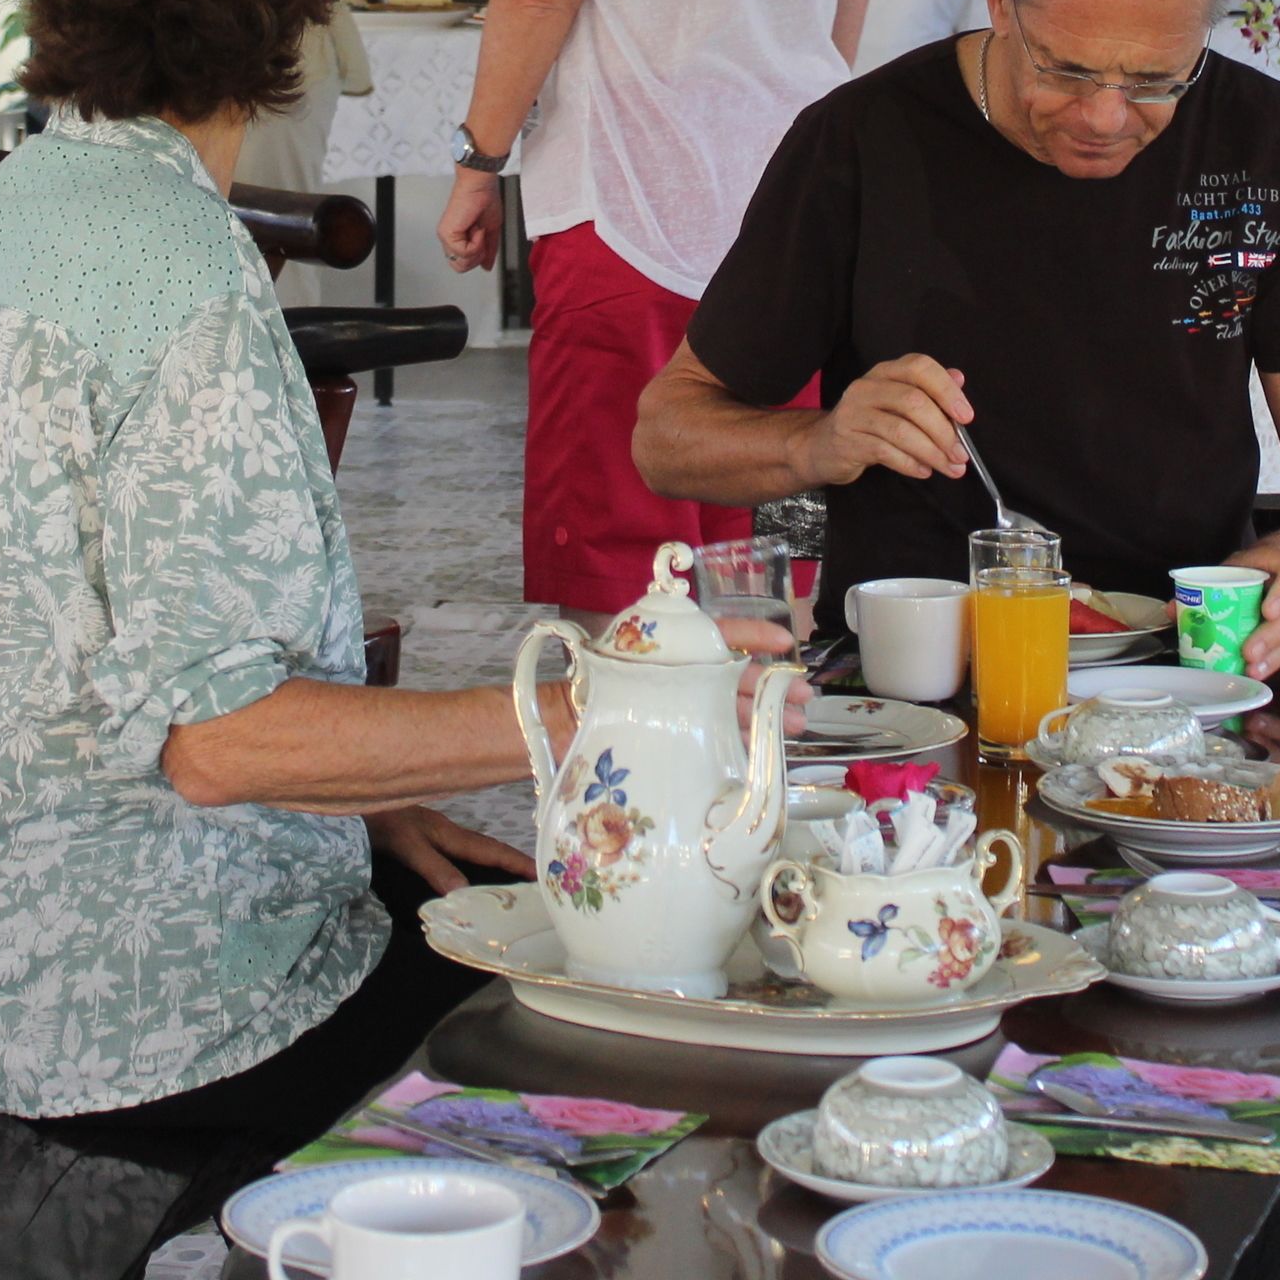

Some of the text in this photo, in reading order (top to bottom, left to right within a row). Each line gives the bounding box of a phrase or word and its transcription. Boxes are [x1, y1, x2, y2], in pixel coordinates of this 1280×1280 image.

[1200, 170, 1251, 187] ROYAL
[1236, 186, 1280, 202] CLUB
[1152, 220, 1233, 251] Fashion
[1189, 273, 1229, 309] OVER
